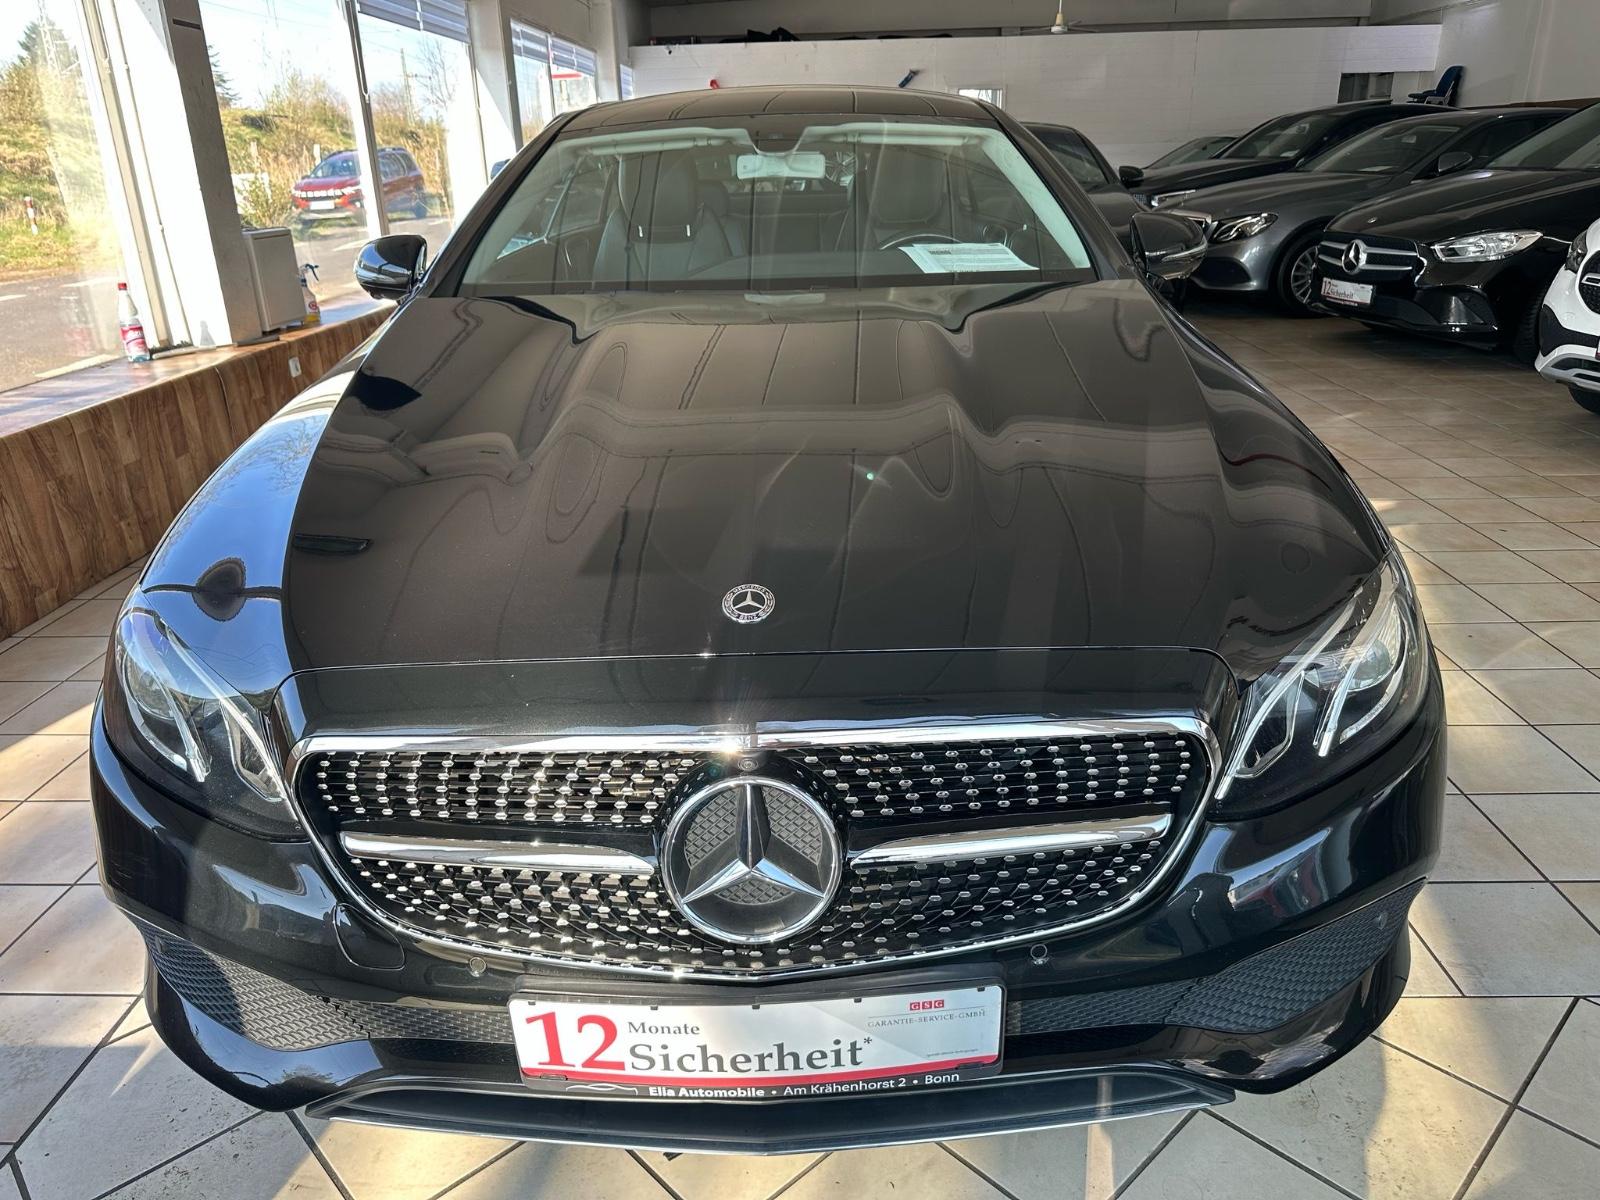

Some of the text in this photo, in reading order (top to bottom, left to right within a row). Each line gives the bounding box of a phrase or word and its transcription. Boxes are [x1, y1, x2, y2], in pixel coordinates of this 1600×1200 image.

[910, 999, 945, 1011] GSG
[627, 1021, 701, 1035] Monate
[525, 1011, 626, 1071] 12
[678, 1086, 765, 1098] Automobile
[783, 1086, 807, 1096] Am
[810, 1079, 895, 1094] Krähenhorst
[898, 1077, 907, 1088] 2
[924, 1073, 961, 1085] Bonn
